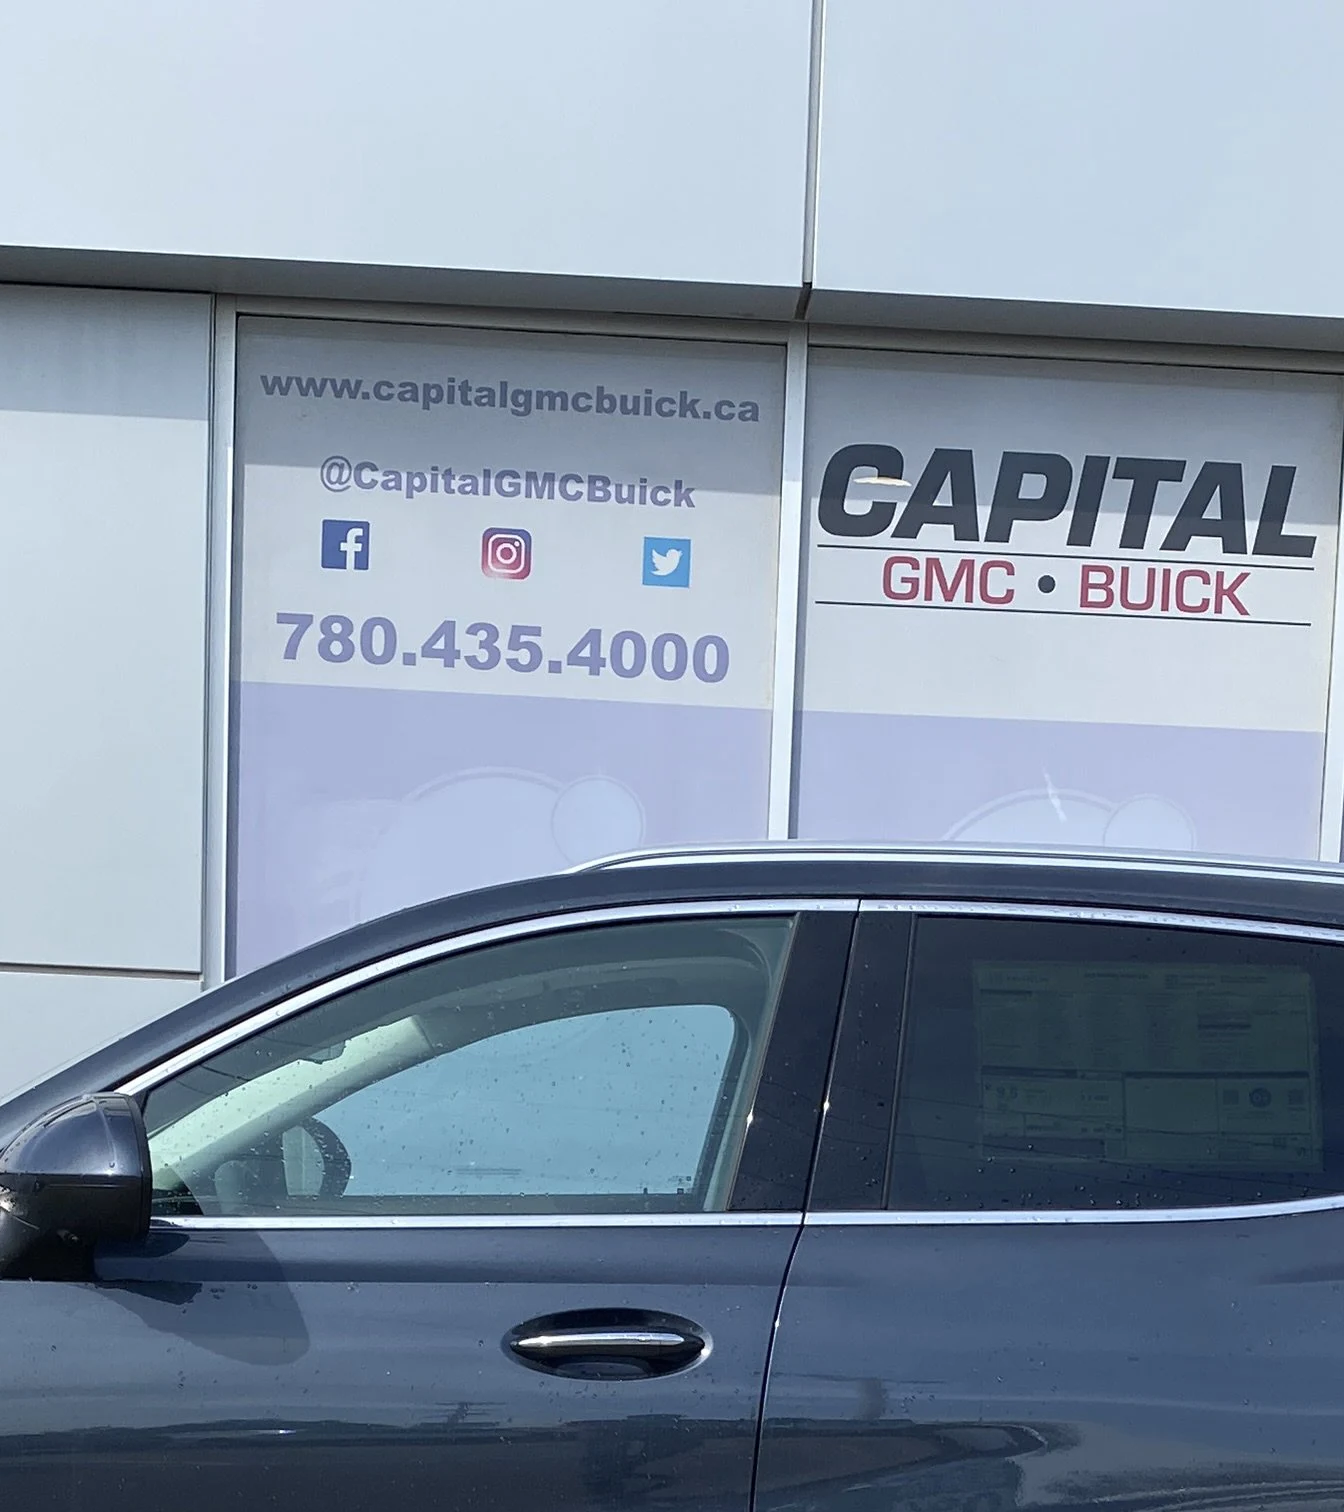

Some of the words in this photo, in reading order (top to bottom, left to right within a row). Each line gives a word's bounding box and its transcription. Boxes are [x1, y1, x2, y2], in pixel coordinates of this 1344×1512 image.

[260, 371, 760, 423] www.capitalgmcbuick.ca
[320, 455, 696, 508] @CapitalGMCBuick
[817, 443, 1317, 558] CAPITAL
[882, 556, 1016, 605] GMC
[1079, 564, 1251, 617] BUICK
[276, 612, 730, 683] 780.435.4000
